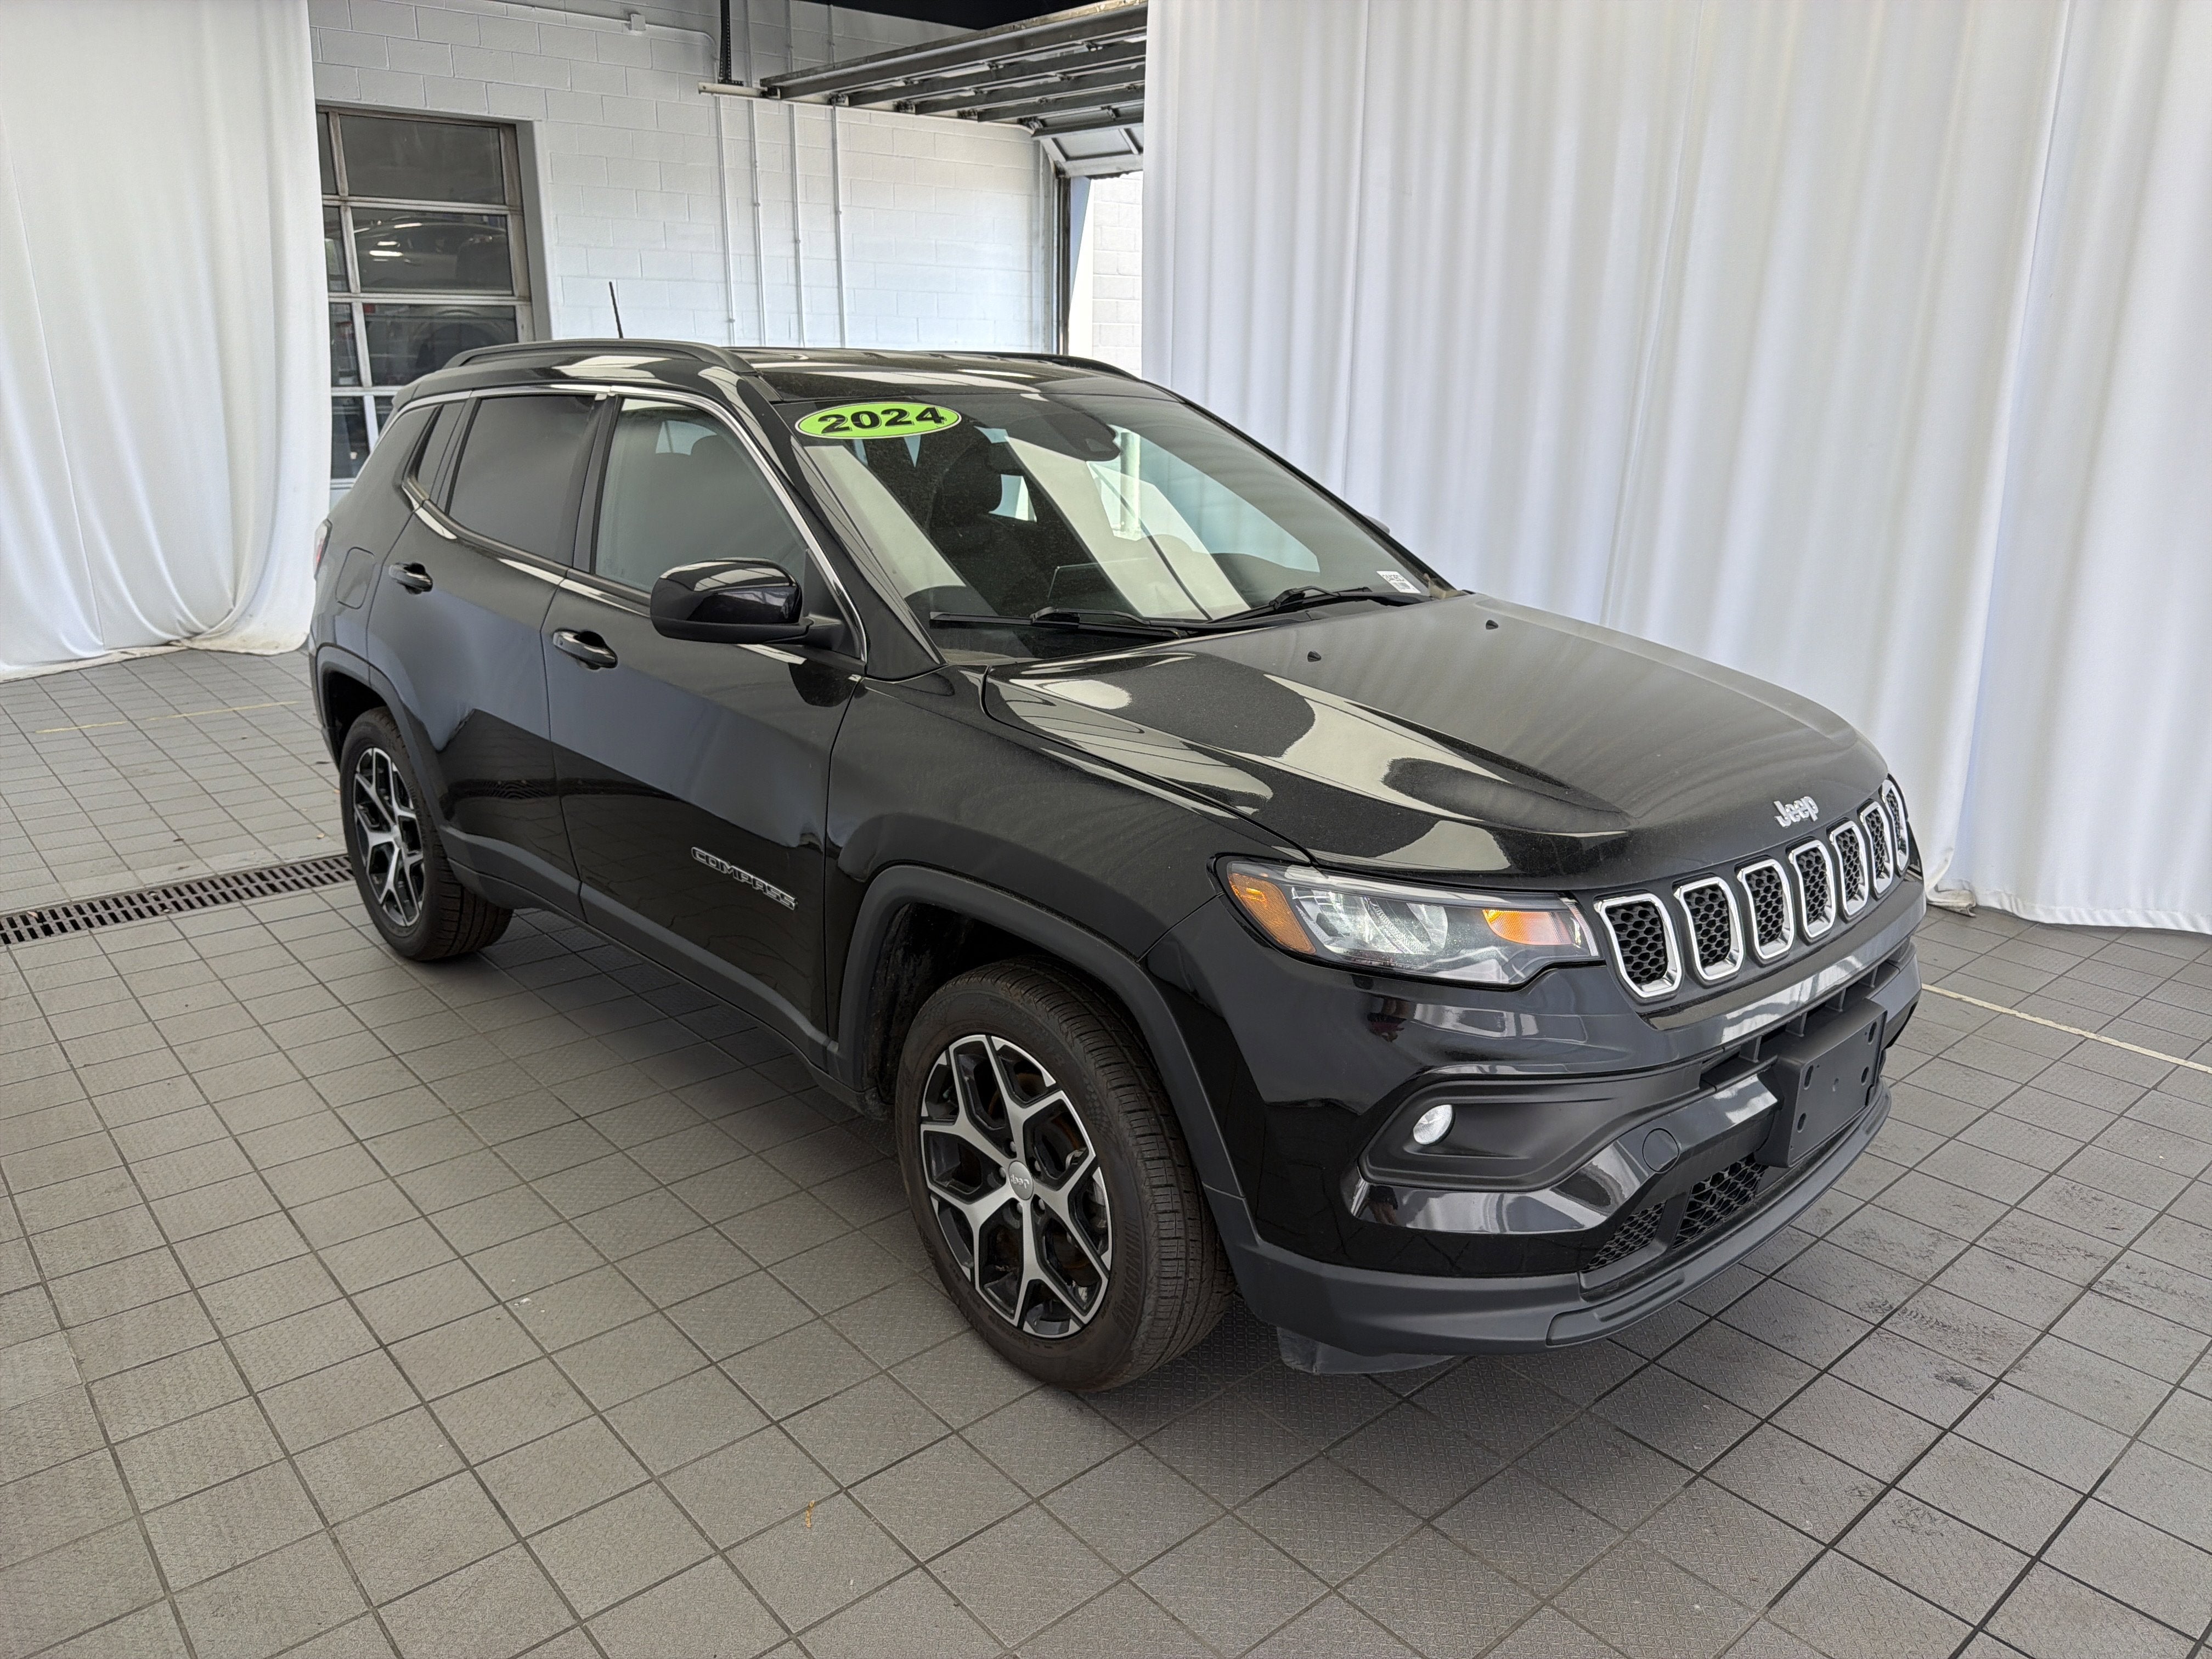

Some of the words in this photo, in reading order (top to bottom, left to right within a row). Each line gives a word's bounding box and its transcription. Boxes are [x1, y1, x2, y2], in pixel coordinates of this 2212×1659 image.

[817, 407, 947, 435] 2024
[1773, 796, 1819, 827] Jeep
[691, 847, 796, 910] COMPASS
